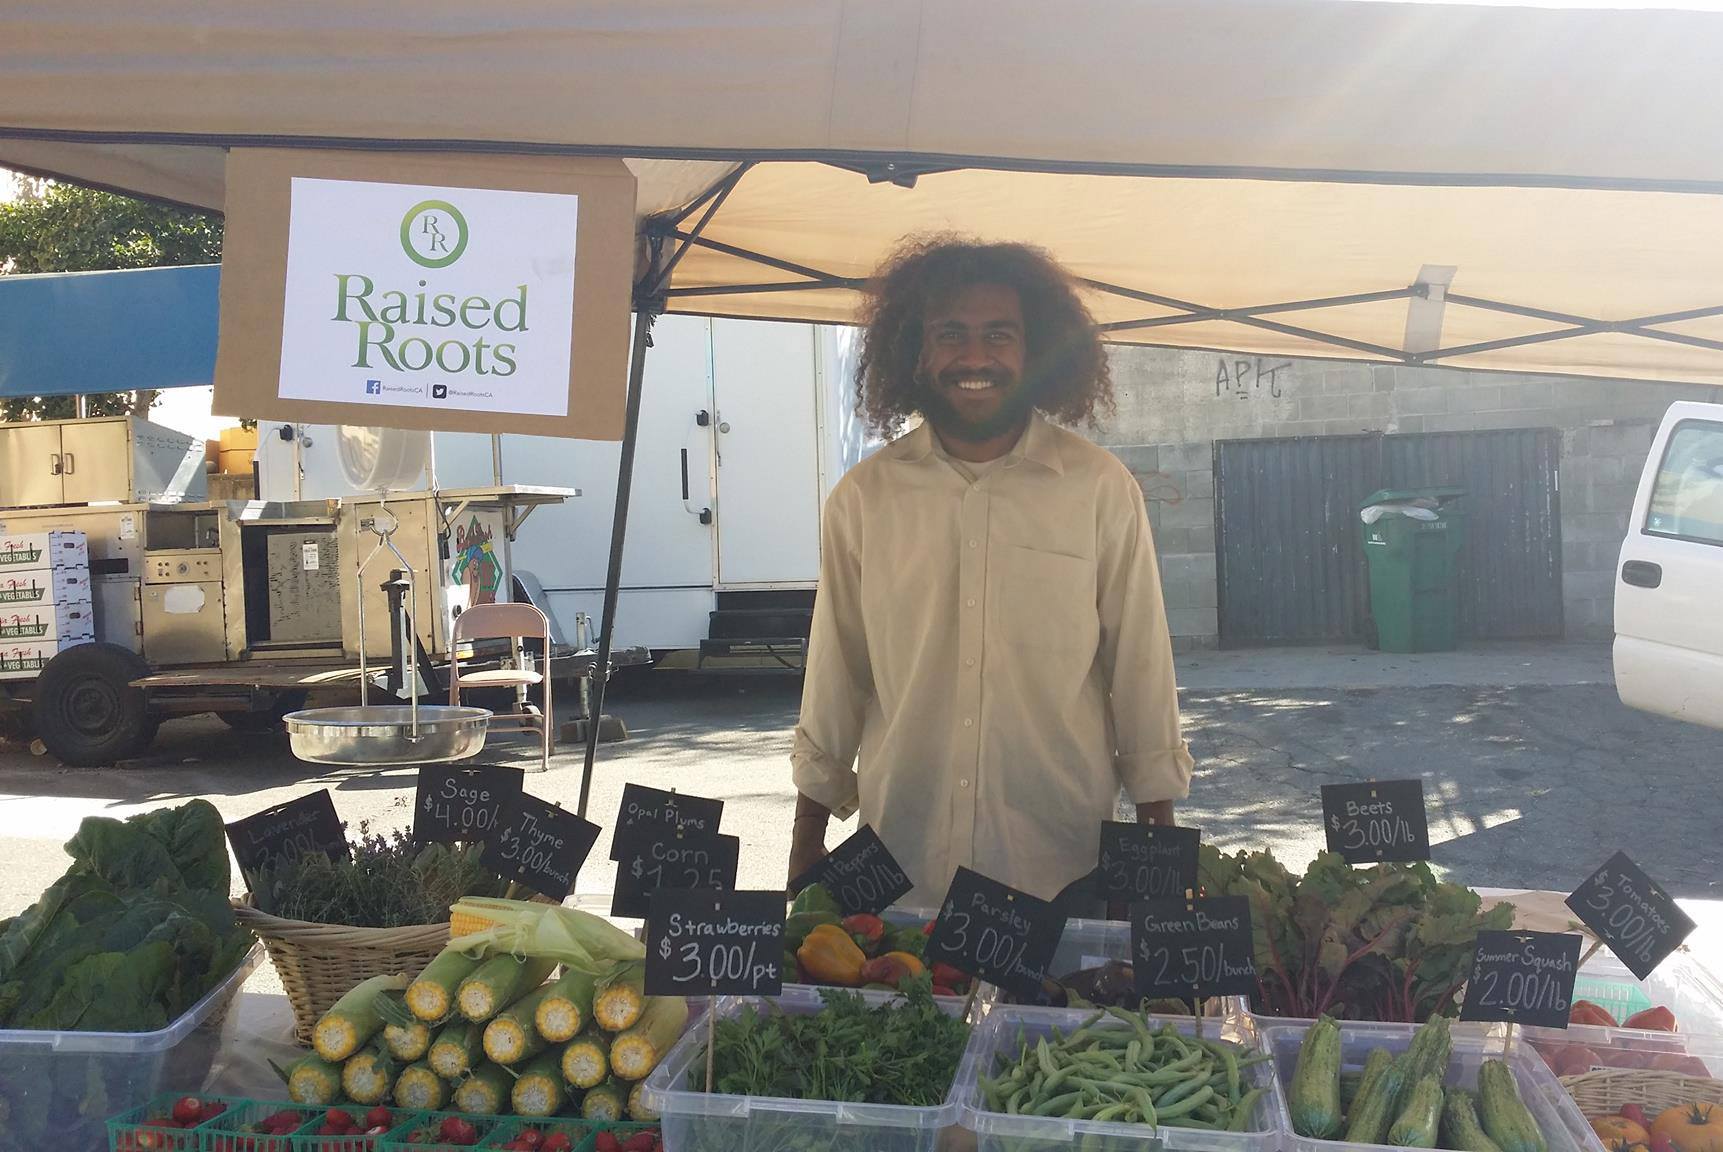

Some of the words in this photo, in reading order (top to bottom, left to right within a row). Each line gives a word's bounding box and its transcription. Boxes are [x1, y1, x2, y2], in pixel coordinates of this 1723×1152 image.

[331, 273, 529, 332] Raised
[351, 320, 517, 377] Roots
[0, 552, 37, 562] VEGETABLS
[2, 590, 40, 601] VEGETABLS
[6, 626, 43, 636] VEGTABLS
[8, 659, 45, 670] VEGTABLS
[440, 778, 491, 806] Sage
[1345, 800, 1393, 817] Beets
[520, 811, 565, 850] Thyme
[628, 802, 658, 820] Opal
[665, 809, 705, 830] Plums
[1331, 814, 1415, 849] $3.00/lb
[501, 827, 570, 886] $3.00/bunch
[652, 842, 709, 865] Corn
[833, 842, 879, 876] Peppers
[1119, 837, 1182, 863] Eggplant
[631, 855, 722, 896] $125
[1101, 851, 1185, 896] $3.00/lb
[971, 892, 1031, 936] Parsley
[1586, 869, 1656, 962] $3.00/lb
[1616, 873, 1671, 935] Tomatoes
[669, 913, 782, 937] Strawberries
[1144, 914, 1194, 934] Green
[1196, 911, 1239, 934] Beans
[659, 936, 777, 990] $3.00/pt
[1476, 947, 1520, 963] Summer
[1521, 944, 1572, 975] Squash
[1473, 963, 1567, 1011] $2.00/lb
